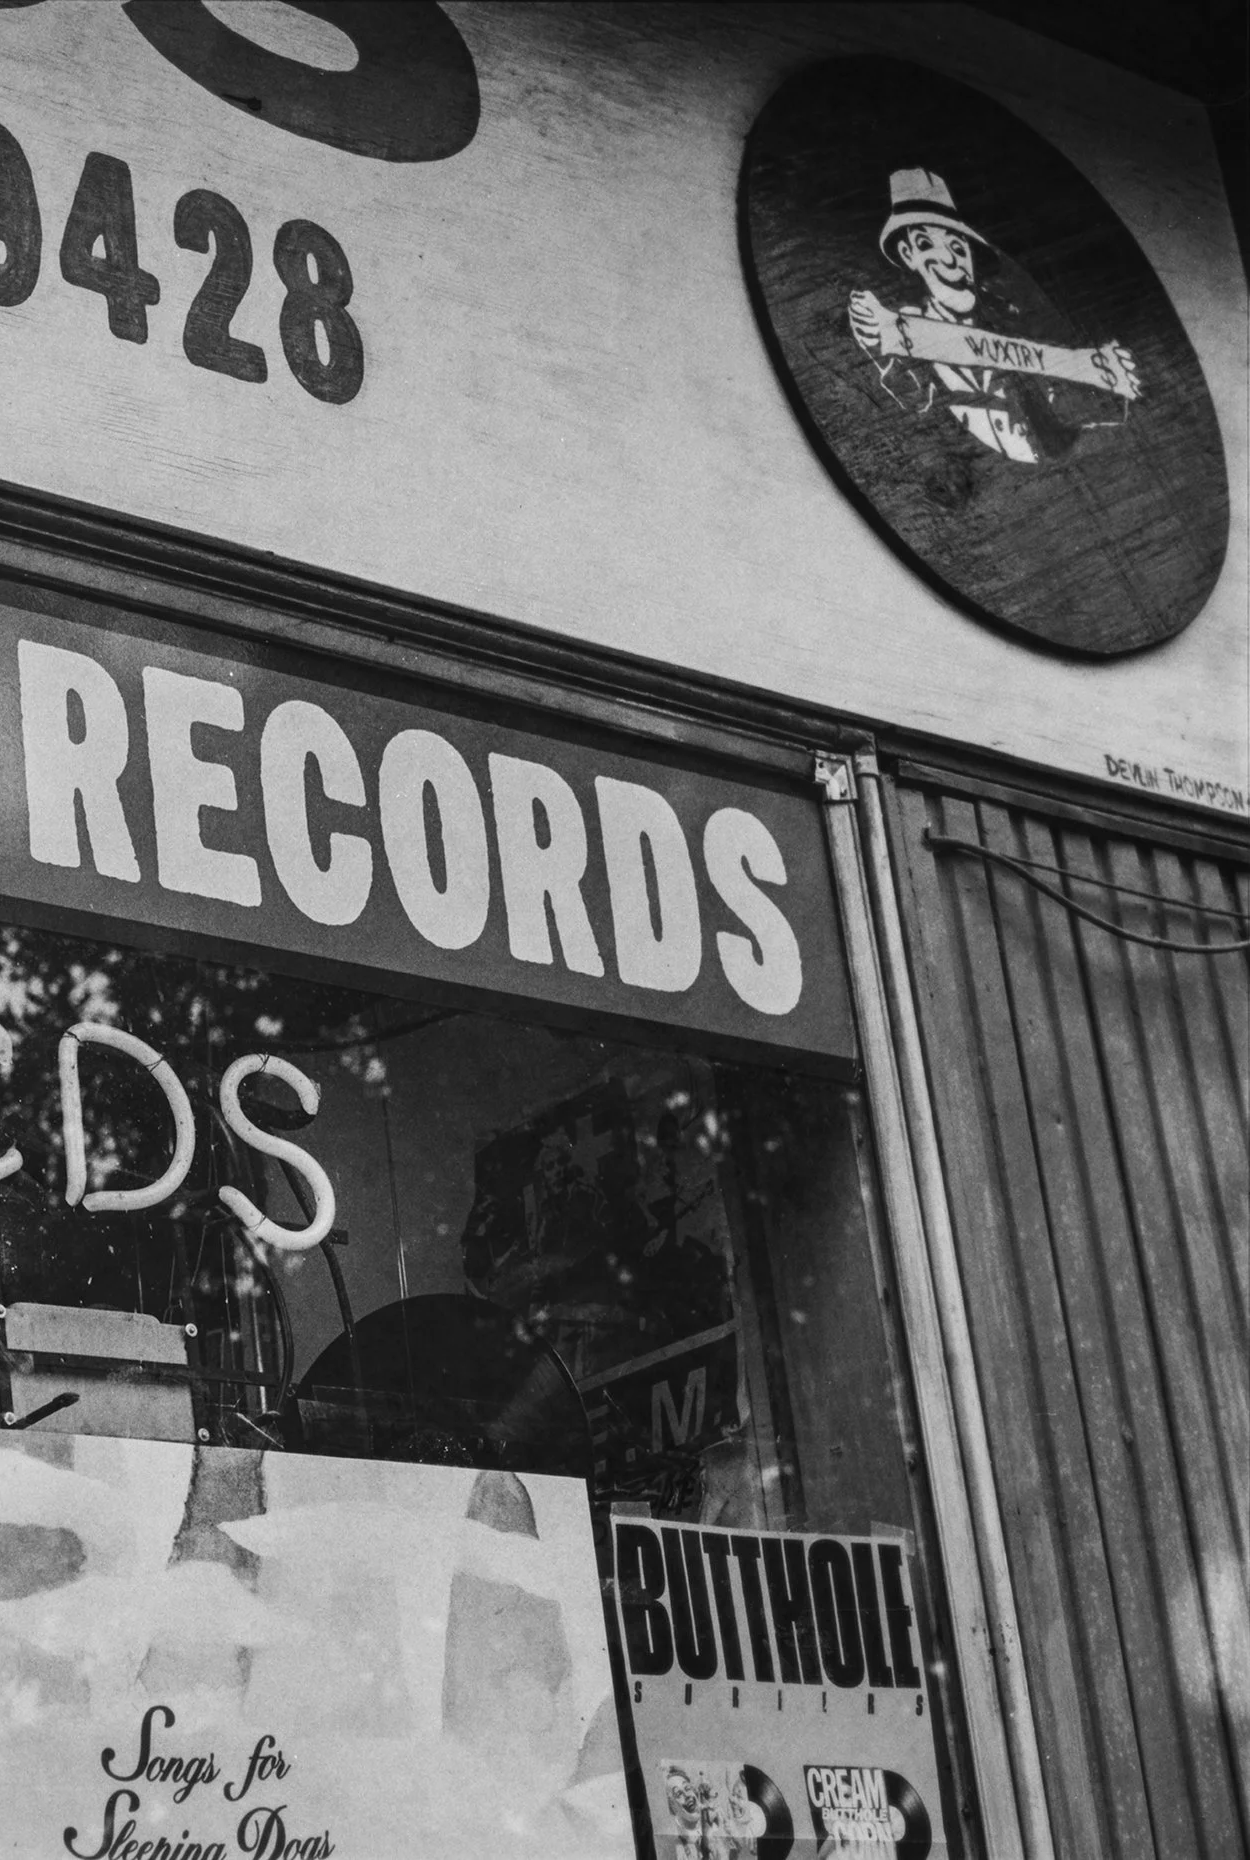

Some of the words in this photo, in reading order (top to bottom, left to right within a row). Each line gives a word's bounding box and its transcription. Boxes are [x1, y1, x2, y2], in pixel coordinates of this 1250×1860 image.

[963, 335, 1046, 371] WUXTRY
[18, 639, 803, 1016] RECORDS
[615, 1523, 921, 1690] BUTTHOLE
[101, 1705, 221, 1804] Songs
[223, 1734, 291, 1802] for
[807, 1767, 887, 1810] CREAM
